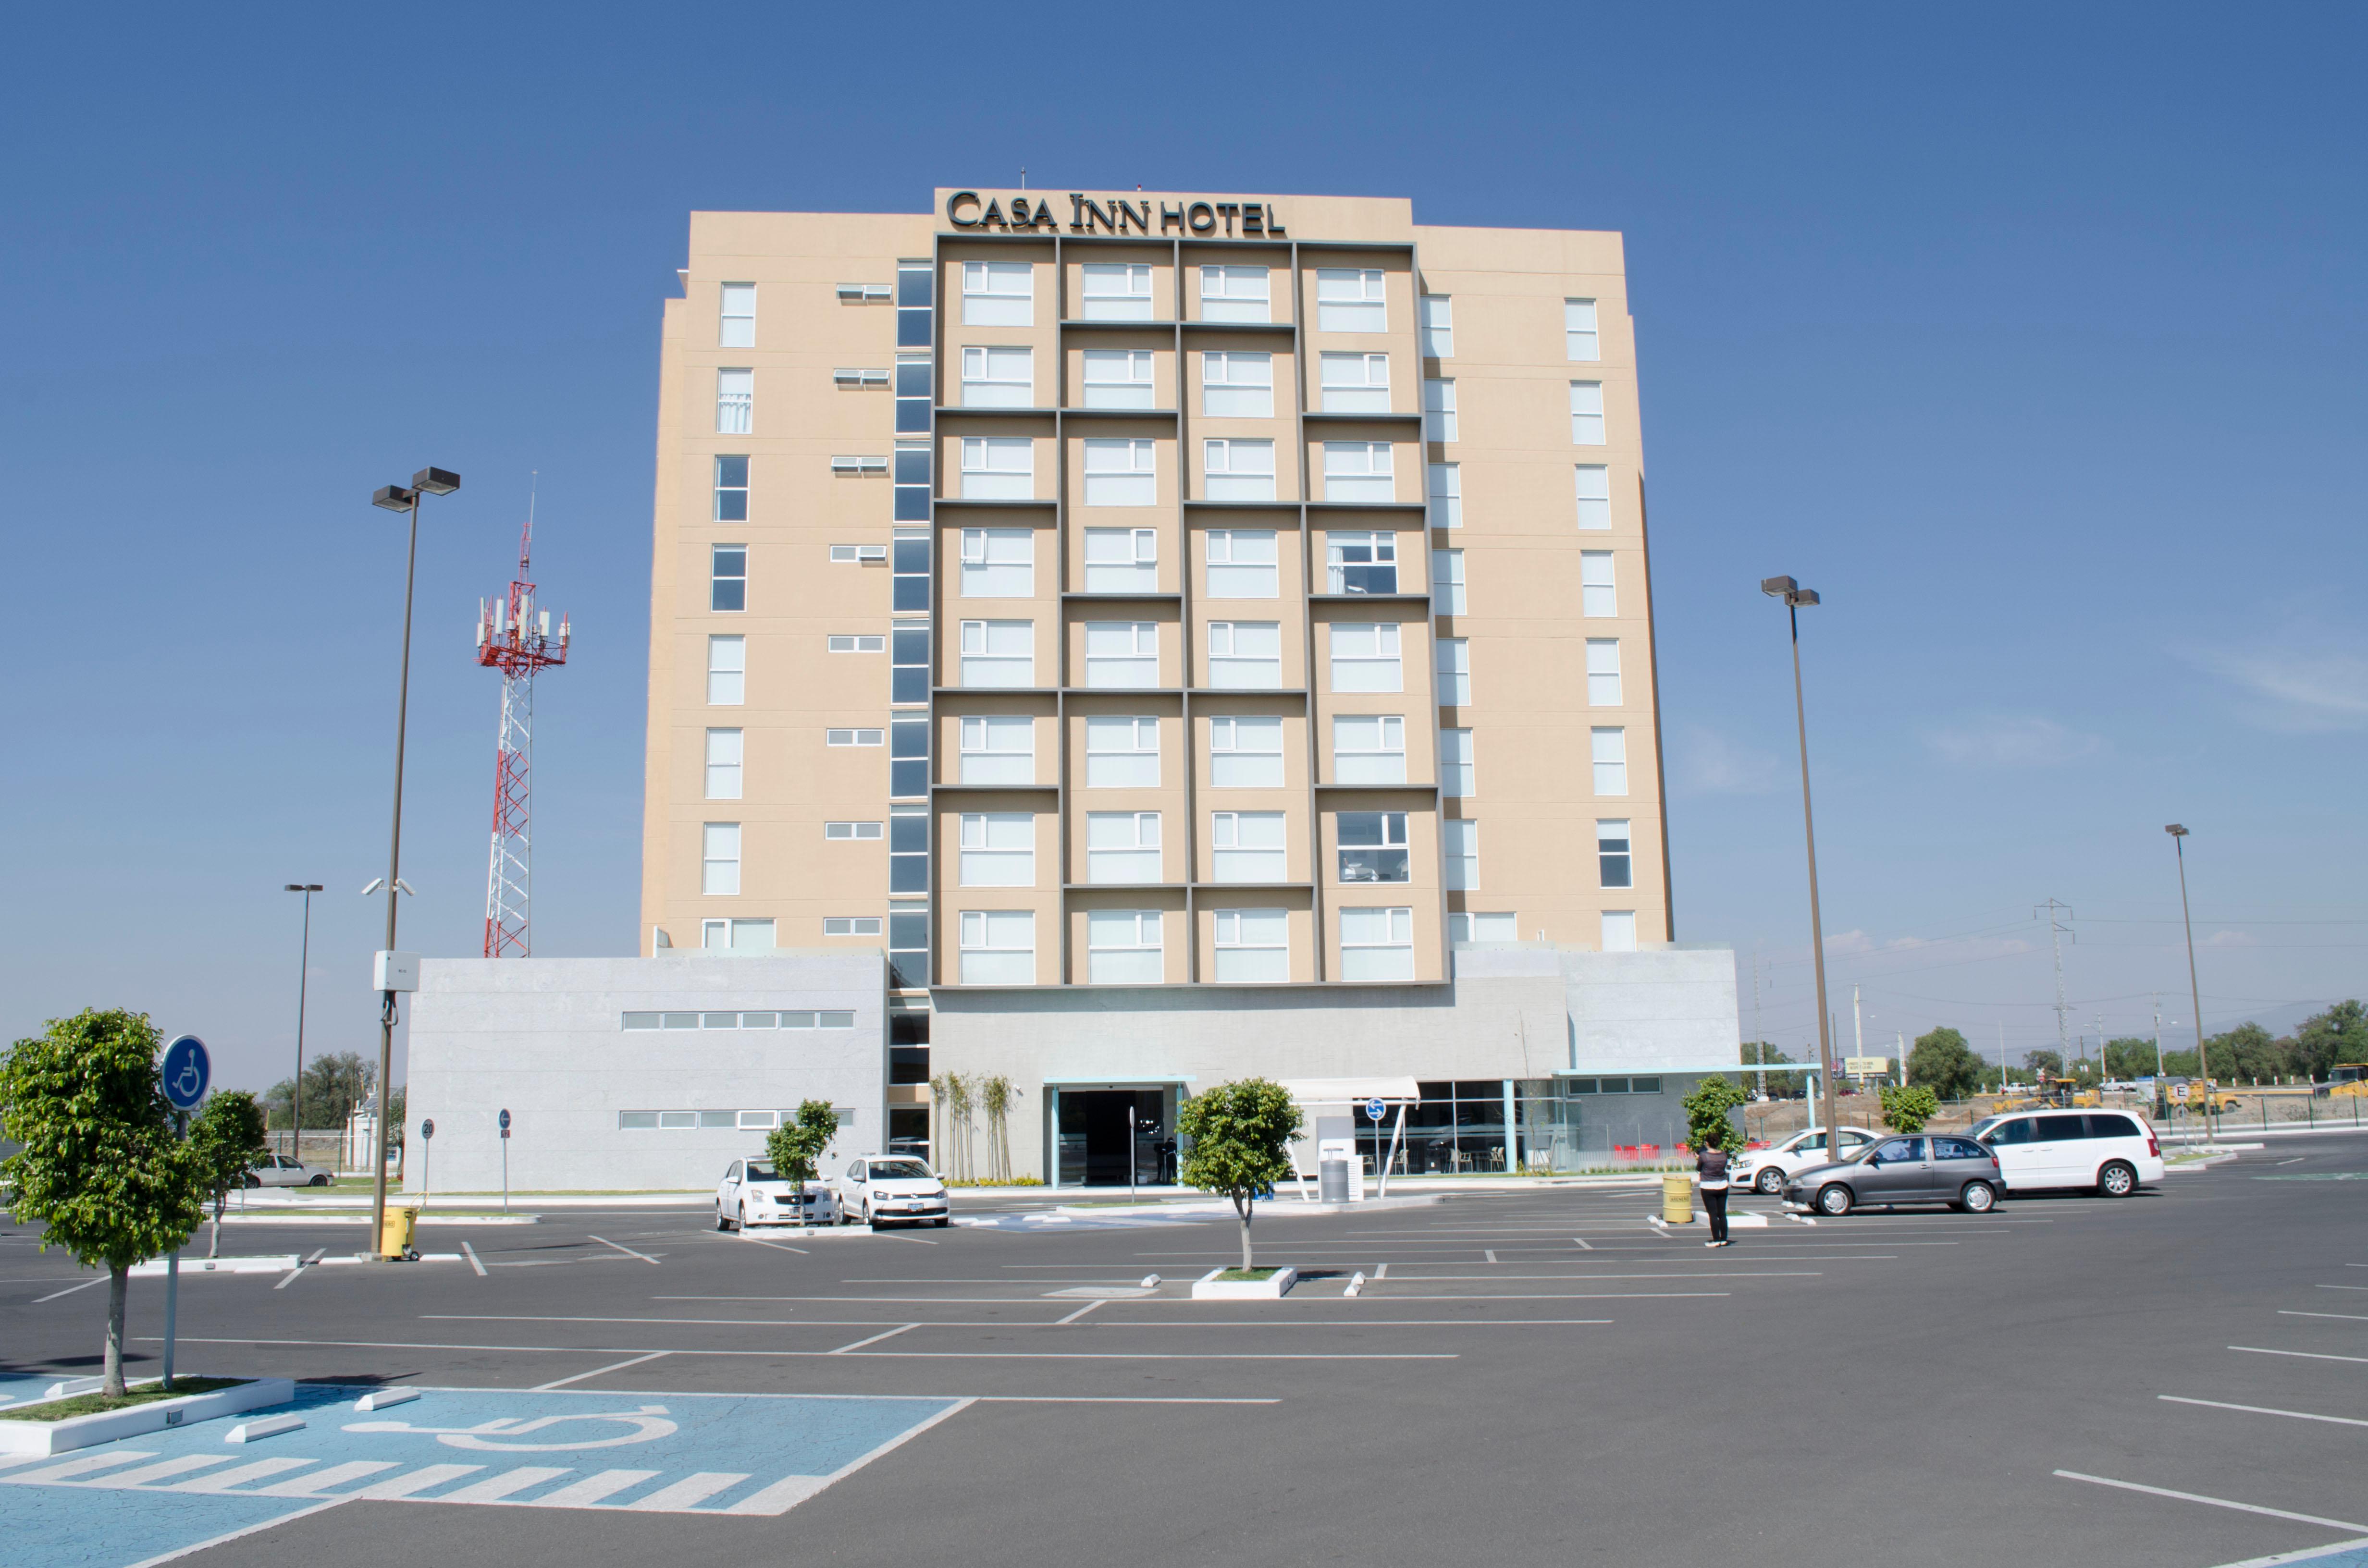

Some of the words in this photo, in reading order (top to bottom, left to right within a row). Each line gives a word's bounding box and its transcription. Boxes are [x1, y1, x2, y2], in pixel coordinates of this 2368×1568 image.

[947, 191, 1057, 226] CASA
[1069, 194, 1148, 229] INN
[1161, 201, 1285, 232] HOTEL
[2177, 1086, 2186, 1096] E
[424, 1124, 433, 1133] 20
